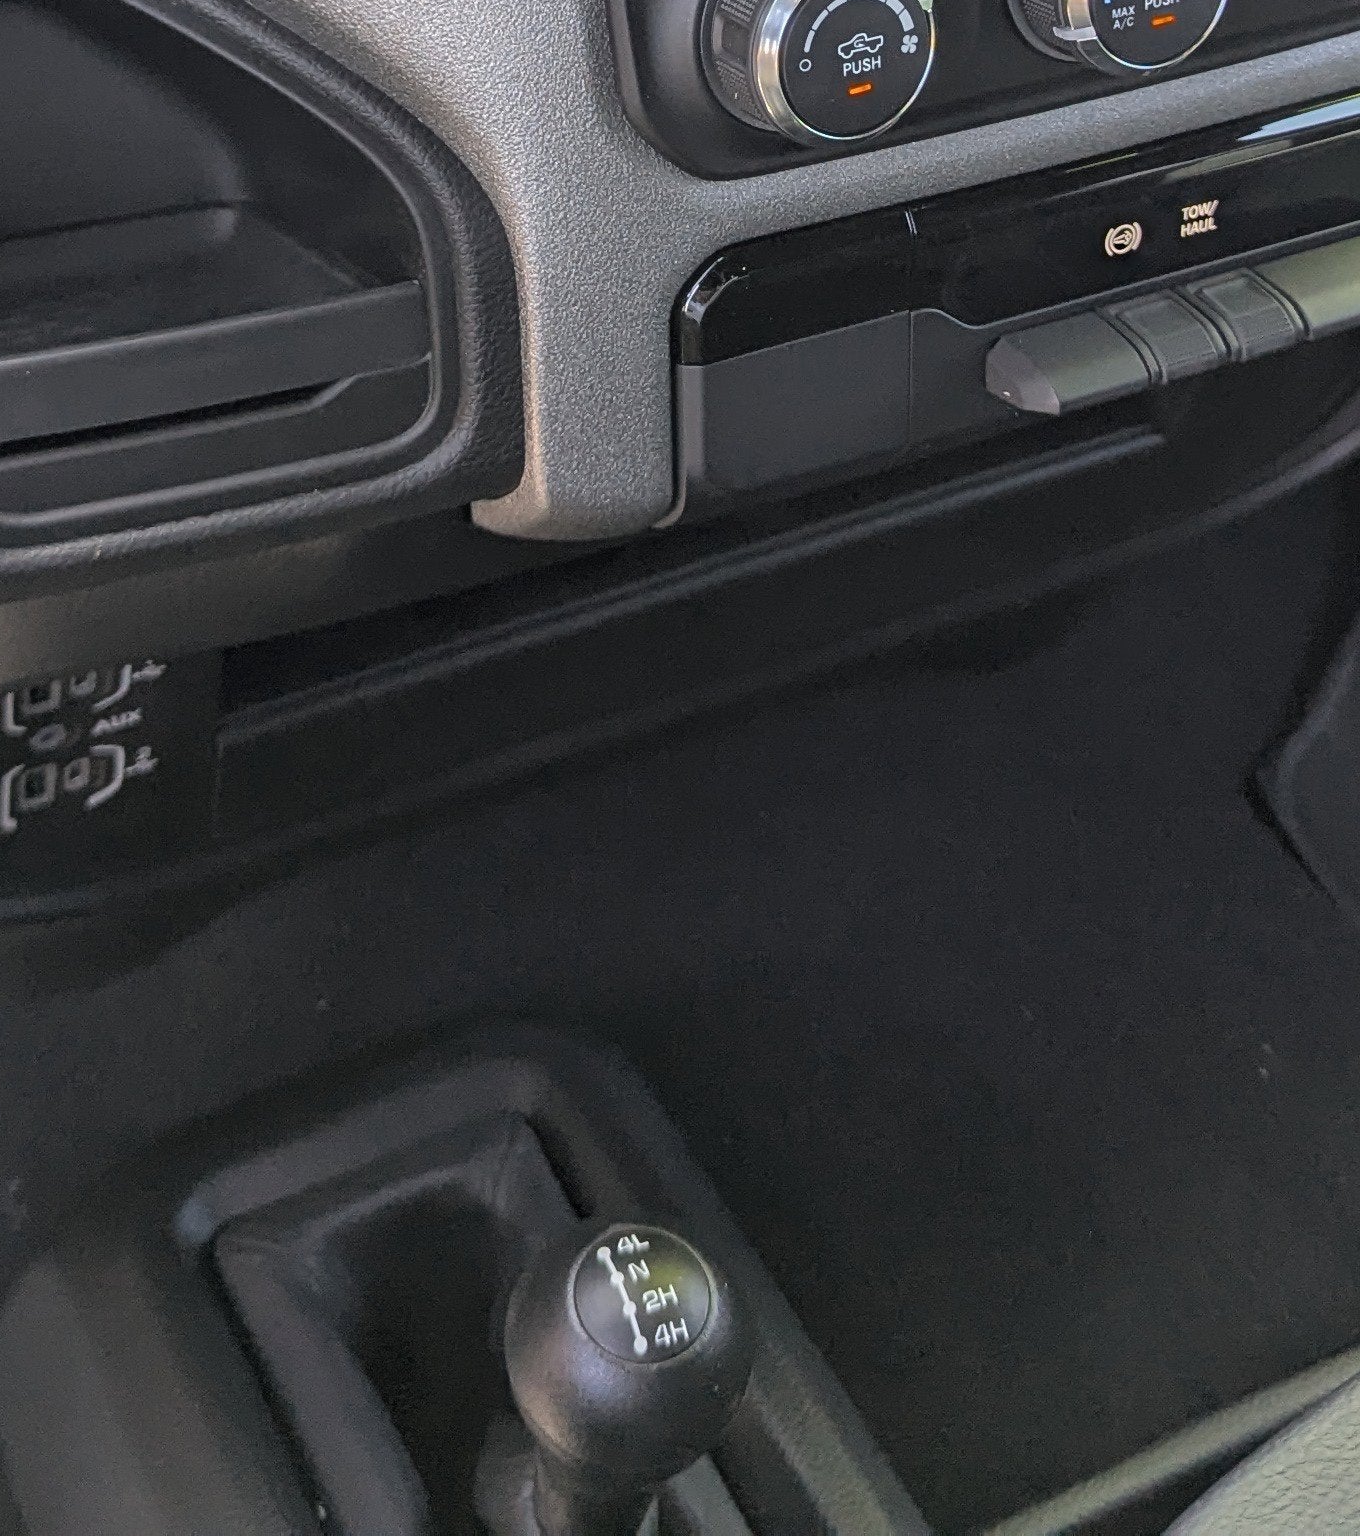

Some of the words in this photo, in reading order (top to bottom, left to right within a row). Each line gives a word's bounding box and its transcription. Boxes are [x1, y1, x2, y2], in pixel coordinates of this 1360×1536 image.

[1112, 4, 1136, 20] MAX
[1113, 17, 1135, 31] A/C
[843, 55, 882, 77] PUSH
[1181, 199, 1219, 221] TOW/
[1180, 216, 1218, 238] HAUL
[89, 707, 142, 737] AUX
[616, 1233, 650, 1255] 4L
[626, 1258, 651, 1283] N
[642, 1284, 679, 1314] 2H
[654, 1317, 690, 1348] 4H
